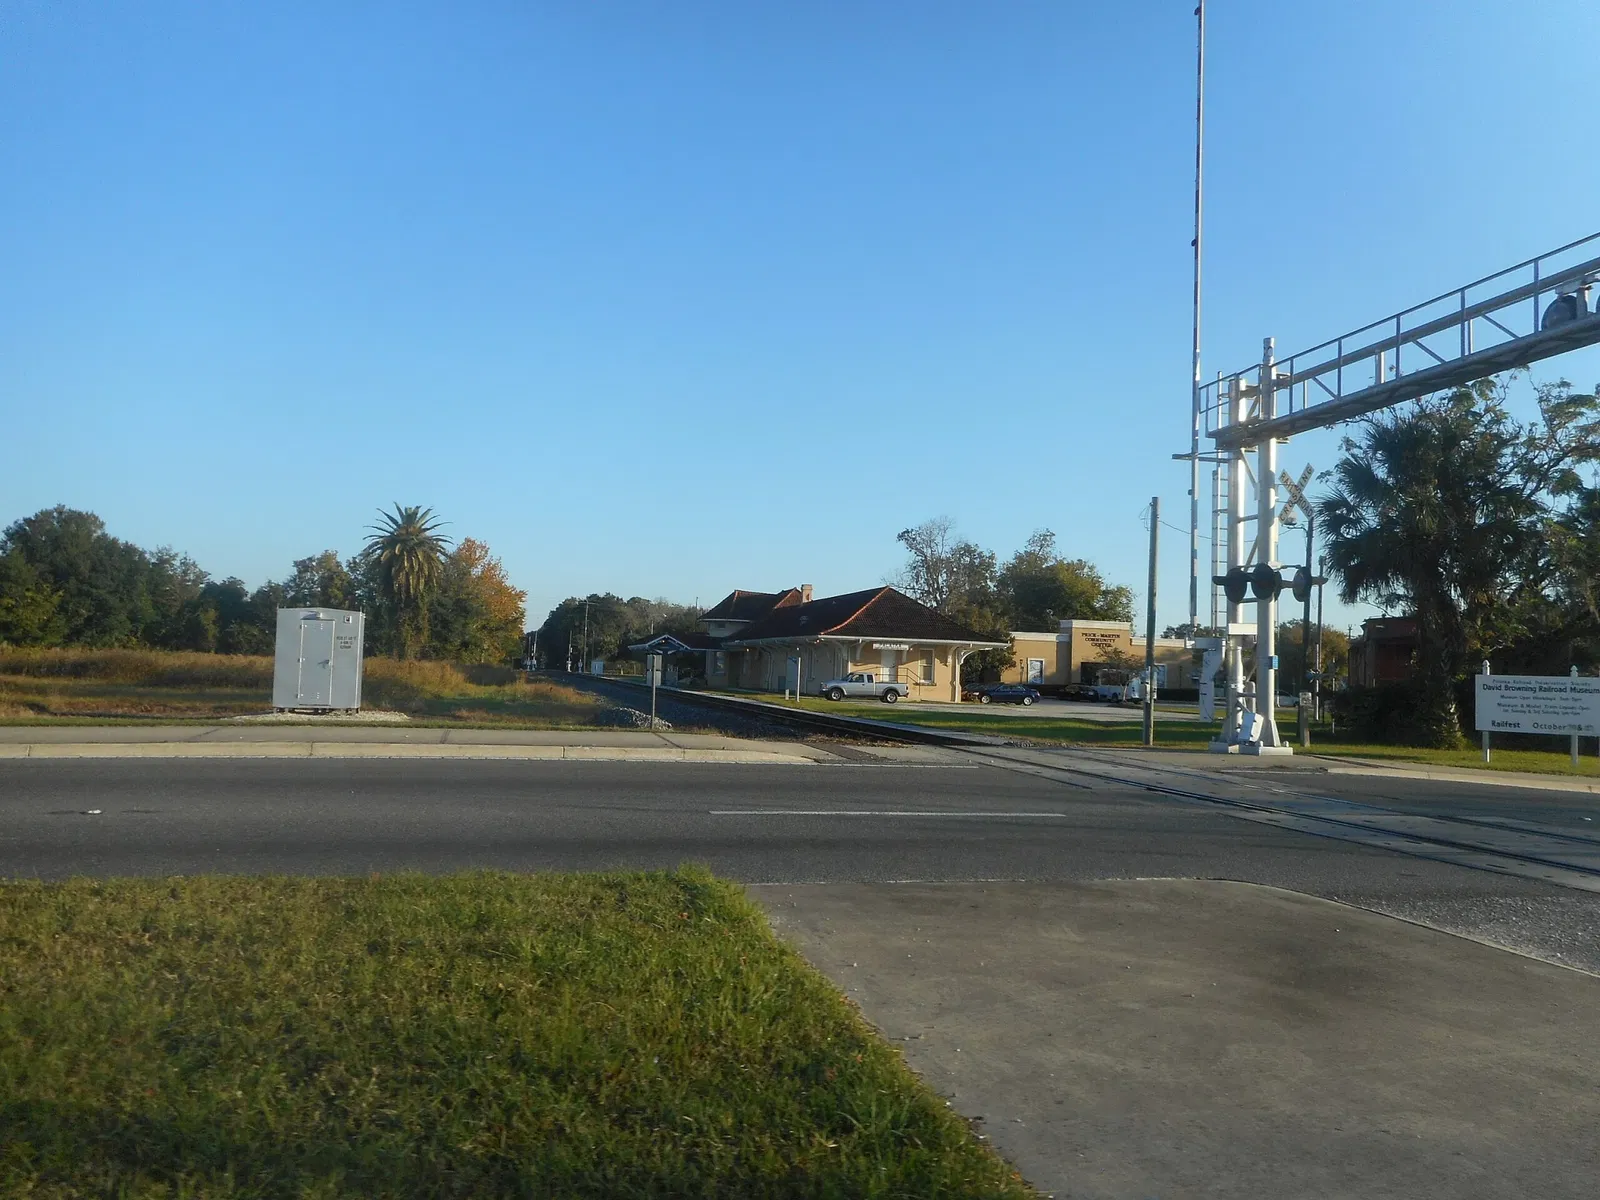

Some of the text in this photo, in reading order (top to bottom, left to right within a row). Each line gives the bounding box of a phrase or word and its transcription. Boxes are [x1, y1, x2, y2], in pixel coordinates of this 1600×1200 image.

[1504, 684, 1536, 694] Browning
[1491, 720, 1520, 728] Railfest
[1532, 722, 1566, 730] October
